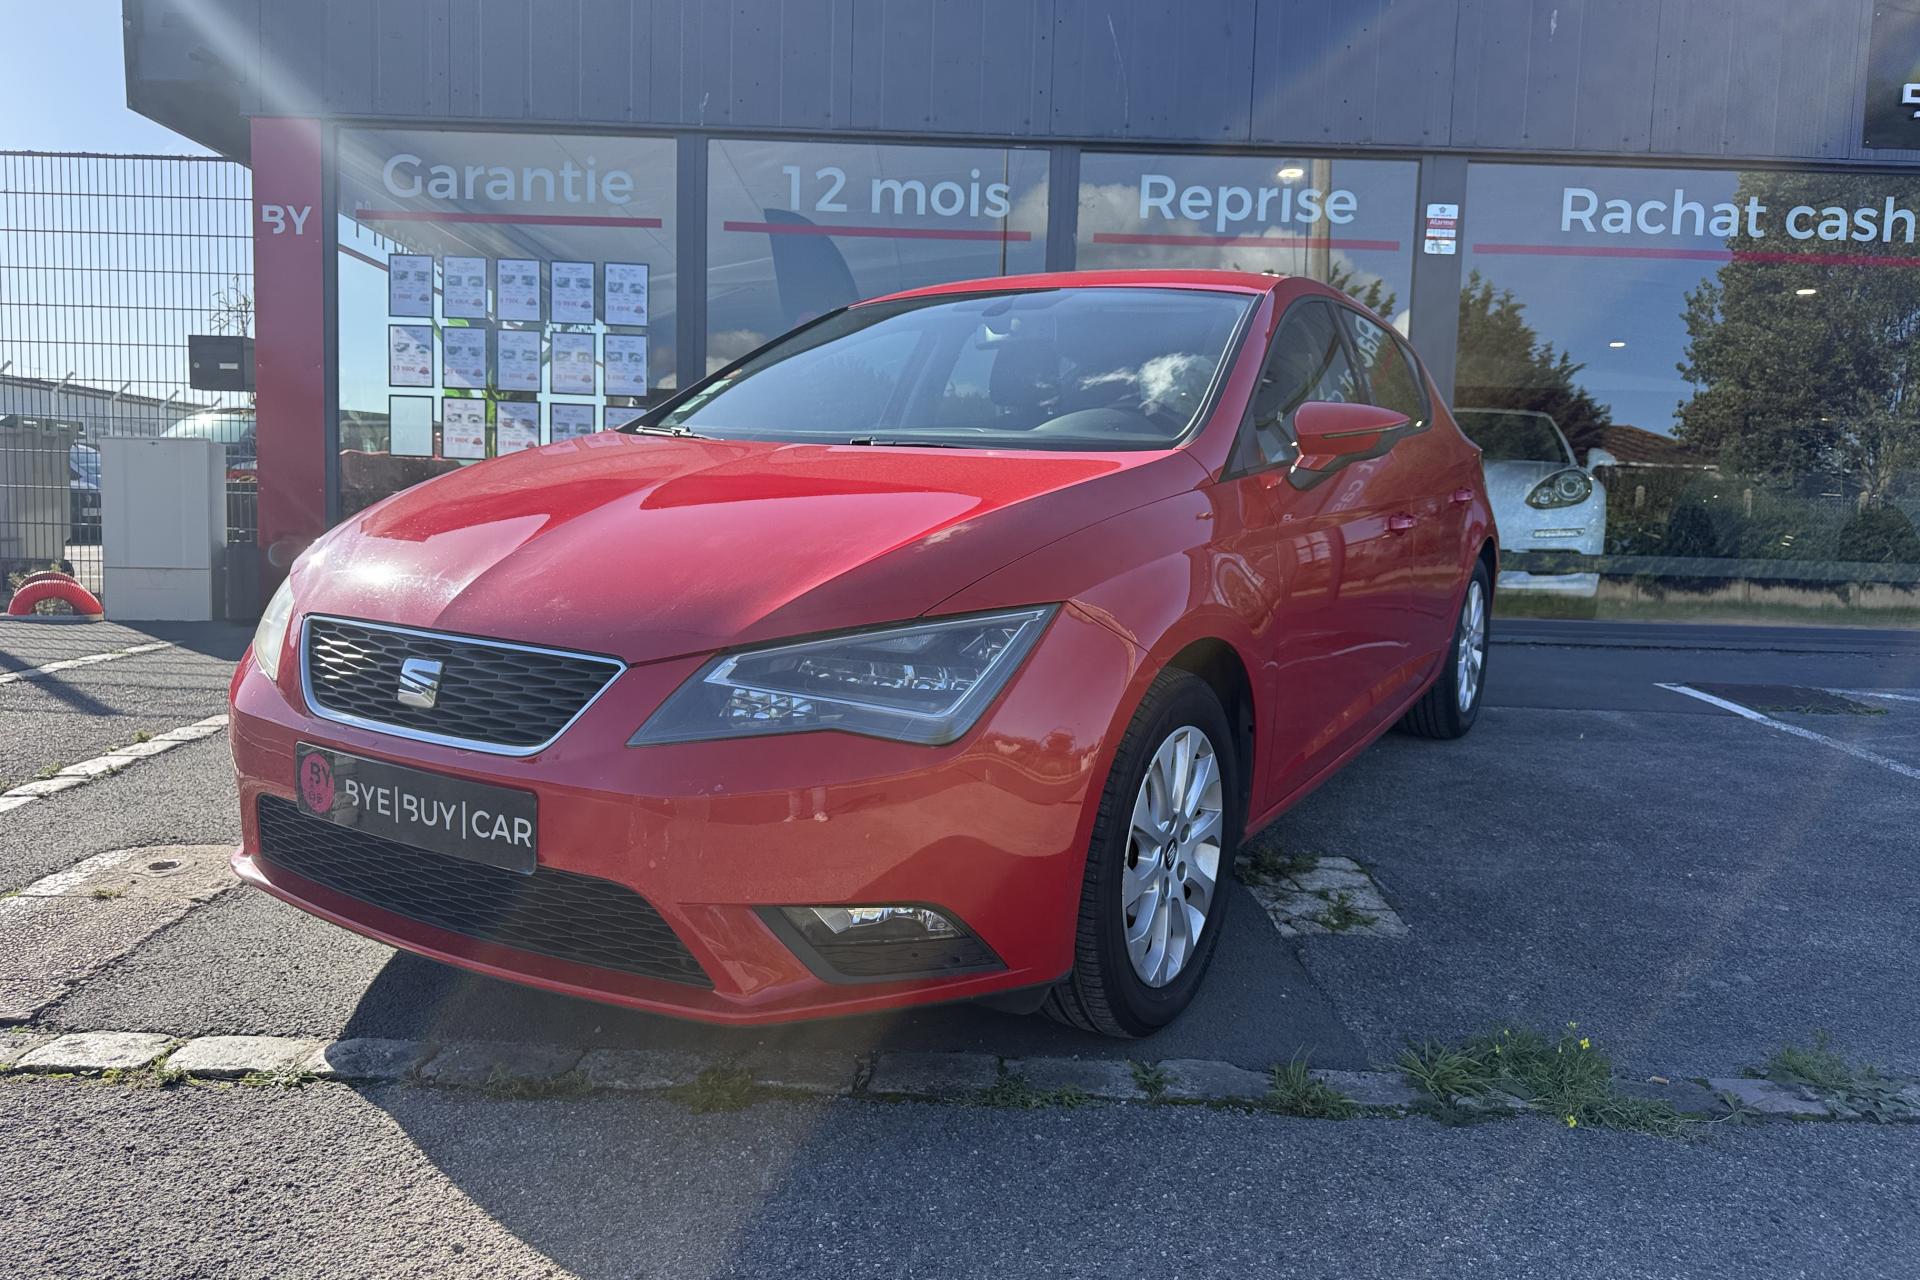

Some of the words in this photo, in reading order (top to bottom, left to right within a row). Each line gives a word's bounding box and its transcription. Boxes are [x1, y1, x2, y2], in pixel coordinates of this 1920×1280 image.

[382, 153, 634, 204] Garantie
[780, 165, 848, 213] 12
[869, 168, 1011, 218] mois
[1139, 174, 1359, 232] Reprise
[261, 204, 312, 236] BY
[1560, 187, 1766, 241] Rachat
[1785, 196, 1916, 243] cash
